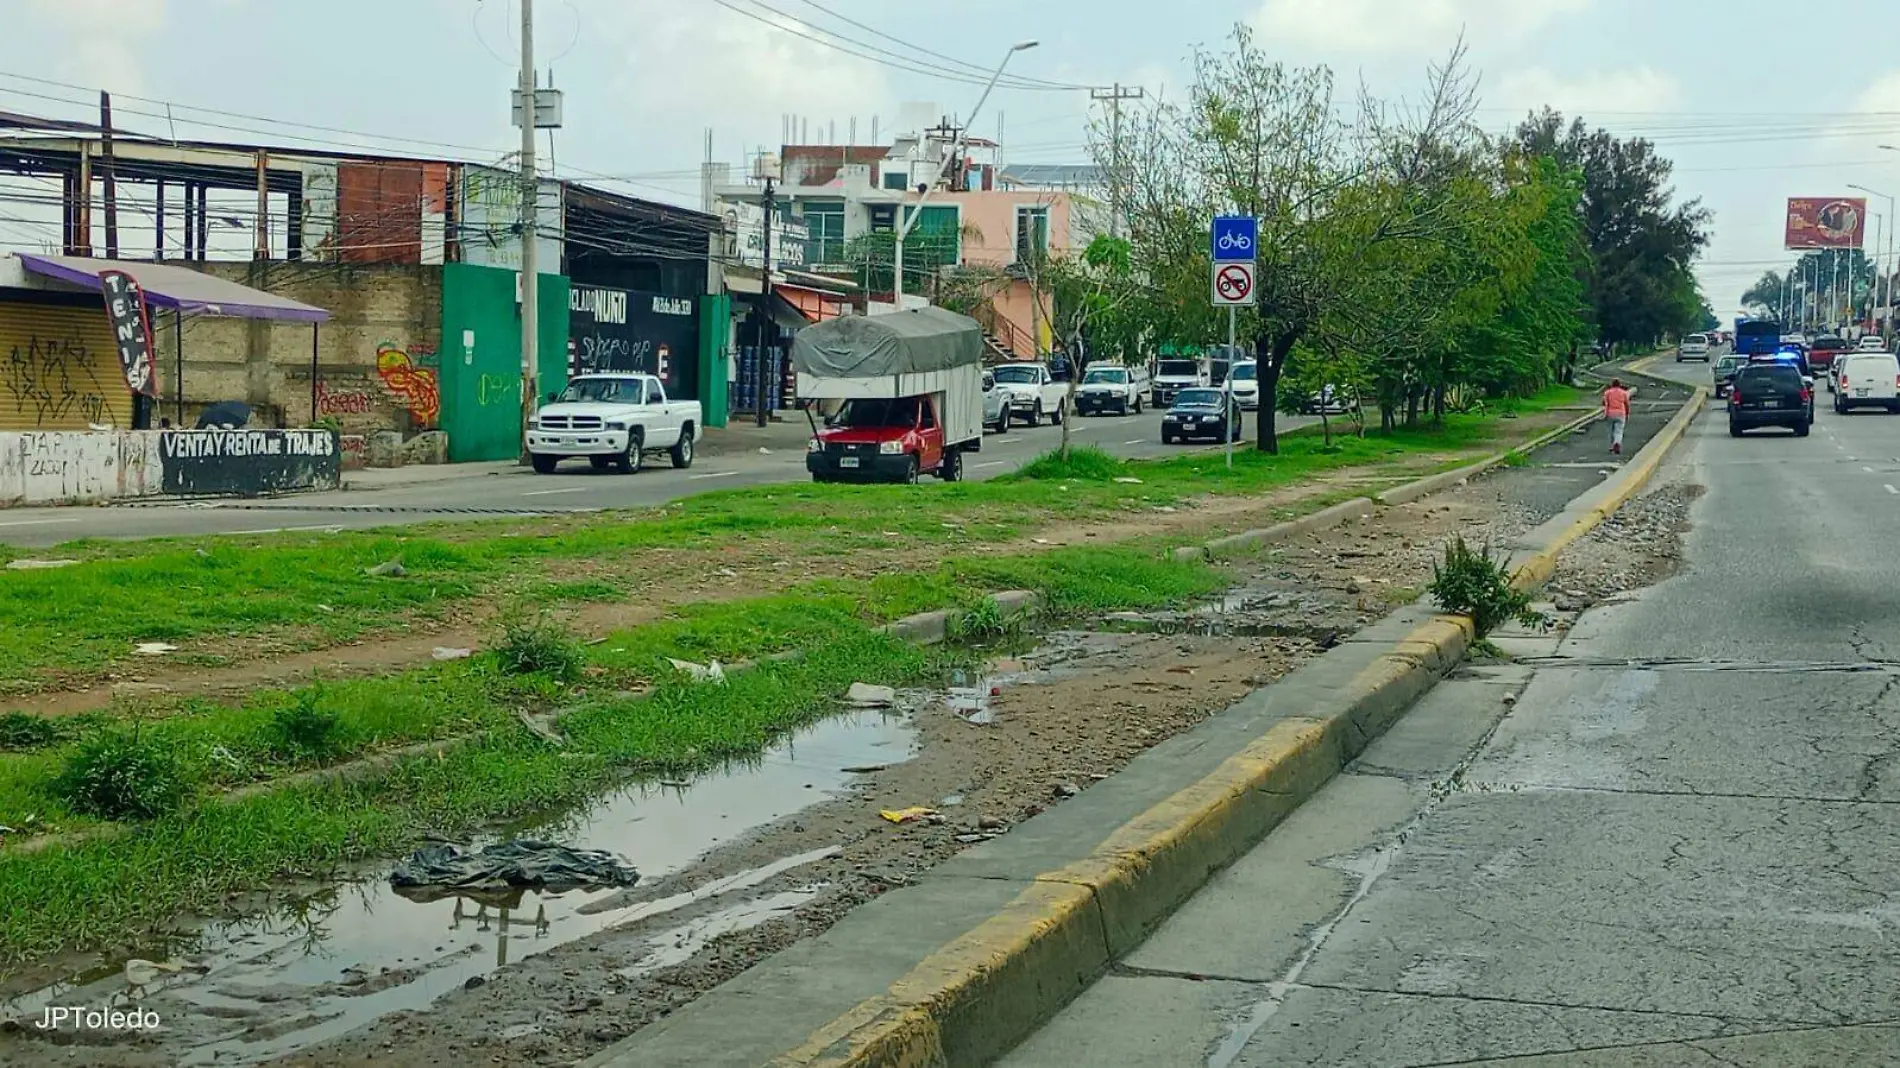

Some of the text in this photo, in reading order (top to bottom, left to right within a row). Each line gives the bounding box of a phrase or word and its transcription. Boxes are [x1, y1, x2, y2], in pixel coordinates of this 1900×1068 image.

[594, 289, 627, 324] NUÑO
[105, 275, 141, 389] TENIS
[164, 433, 214, 458] VENTA
[225, 433, 268, 457] RENTA
[285, 431, 334, 457] TRAJES
